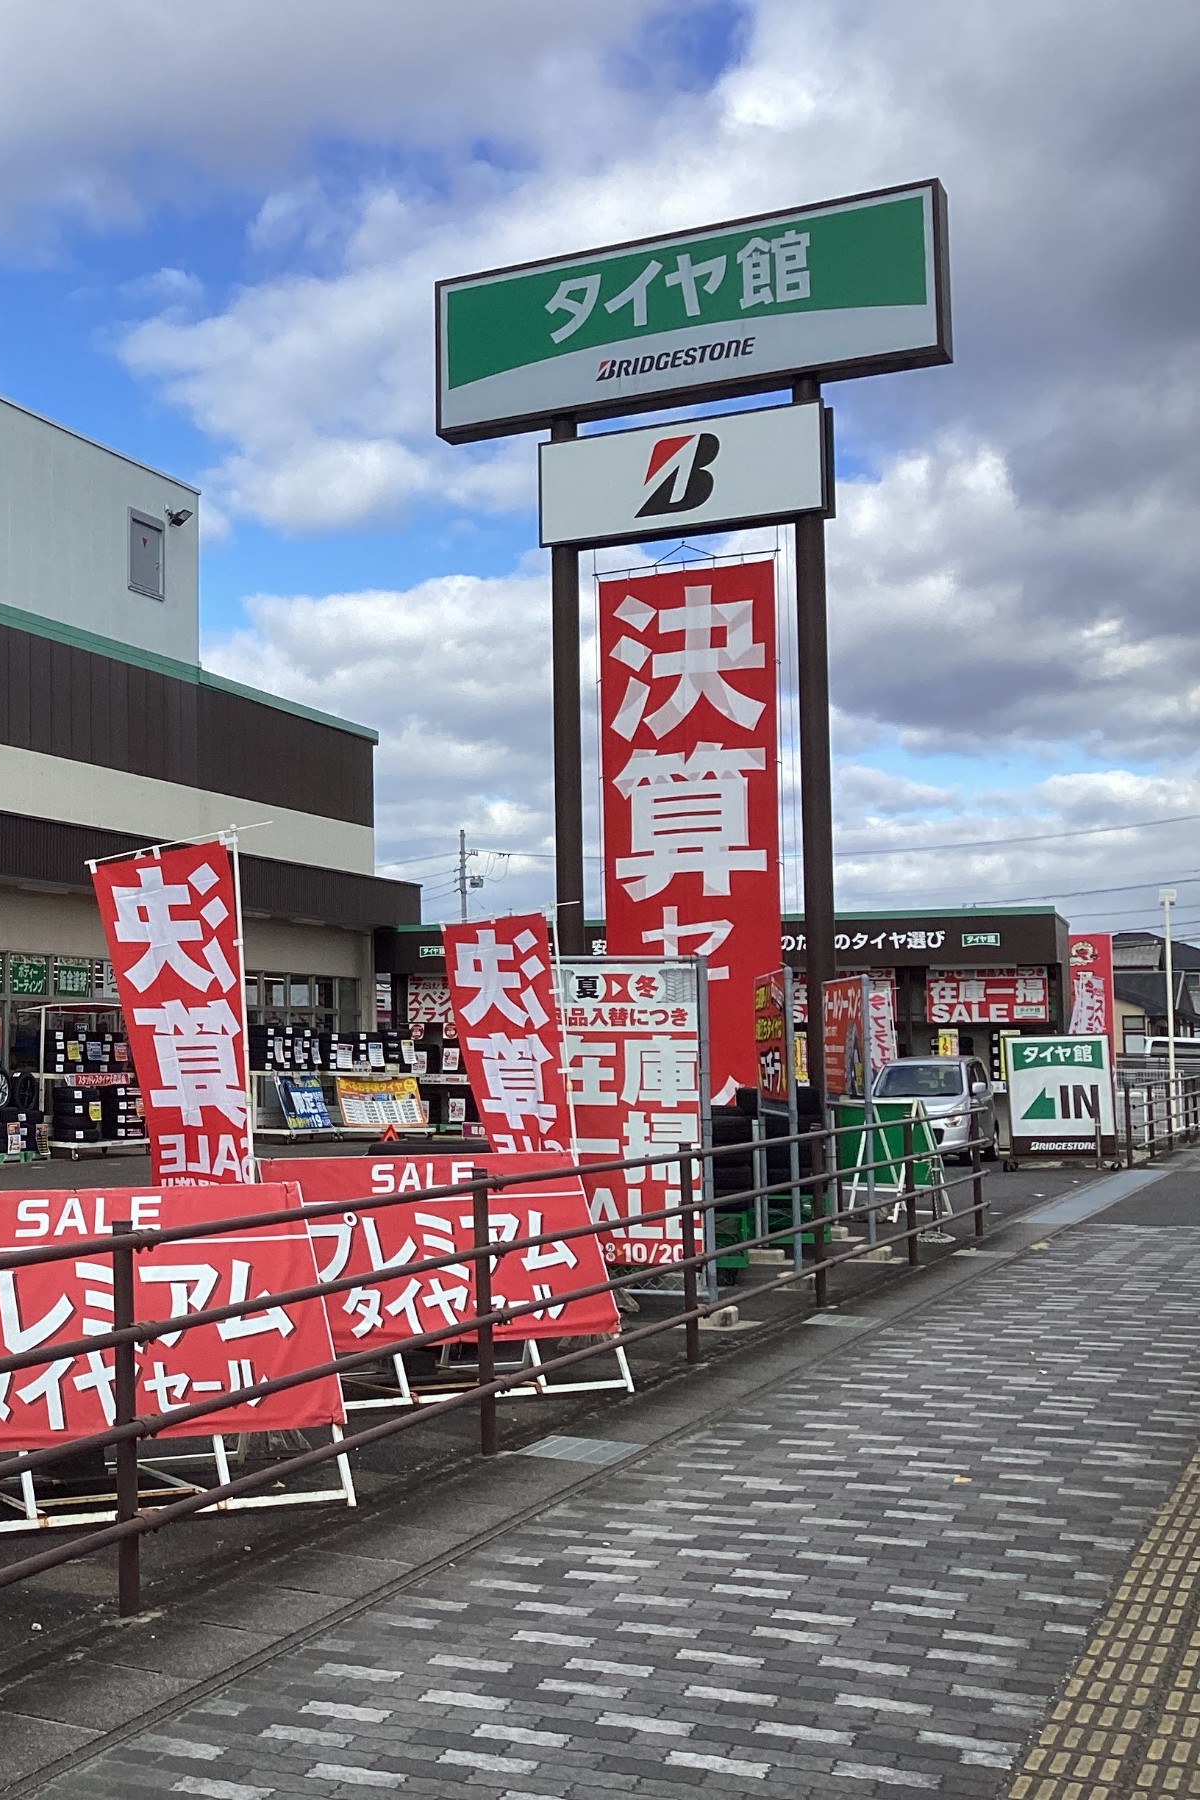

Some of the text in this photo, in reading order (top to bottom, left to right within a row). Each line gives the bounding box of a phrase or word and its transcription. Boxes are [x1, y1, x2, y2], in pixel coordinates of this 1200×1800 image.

[544, 231, 811, 344] タイヤ館
[596, 337, 756, 382] BRIDGESTONE
[13, 978, 44, 993] コーティング
[575, 974, 659, 1000] 夏 冬
[930, 980, 1044, 1004] 在庫一掃
[931, 1003, 1010, 1023] SALE
[1023, 1045, 1093, 1064] タイヤ館
[1060, 1084, 1099, 1119] IN
[371, 1162, 475, 1194] SALE
[15, 1196, 162, 1239] SALE
[590, 1188, 704, 1240] ALE
